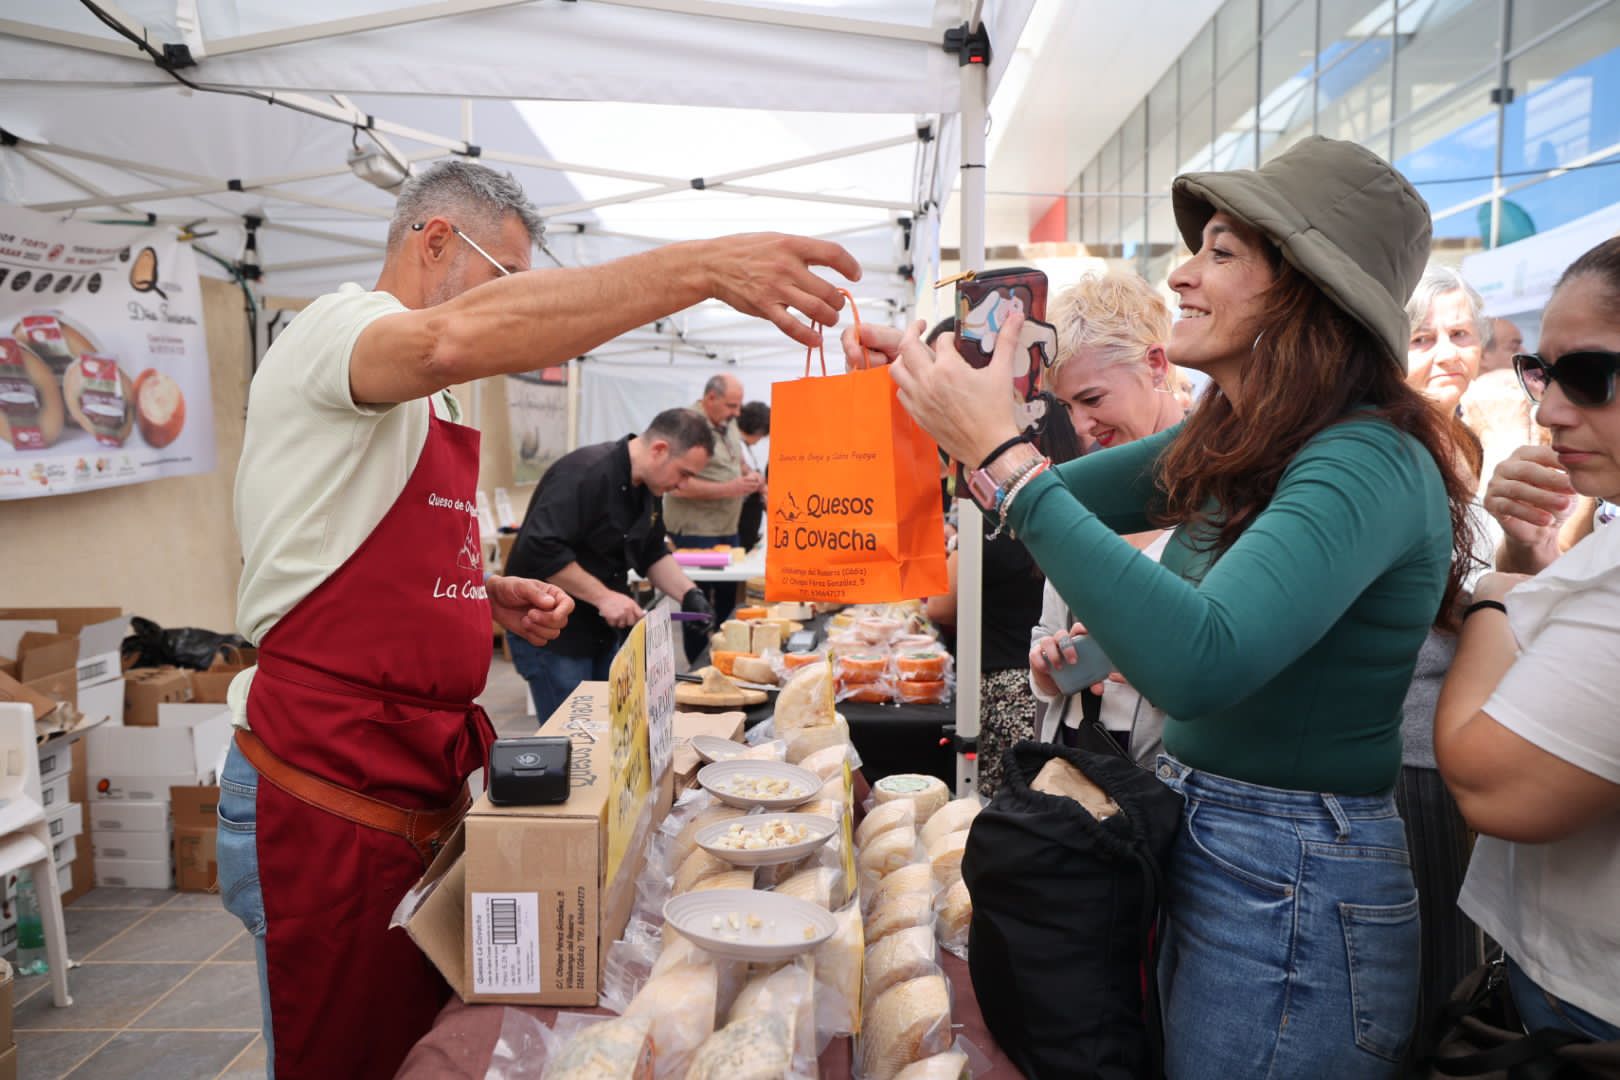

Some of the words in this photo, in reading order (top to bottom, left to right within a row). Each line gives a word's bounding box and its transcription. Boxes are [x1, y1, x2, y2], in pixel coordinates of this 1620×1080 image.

[428, 493, 453, 508] Queso
[454, 498, 464, 511] de
[807, 494, 874, 519] Quesos
[774, 526, 789, 549] La
[794, 527, 877, 551] Covacha
[433, 576, 457, 598] La
[570, 745, 597, 788] Quesos
